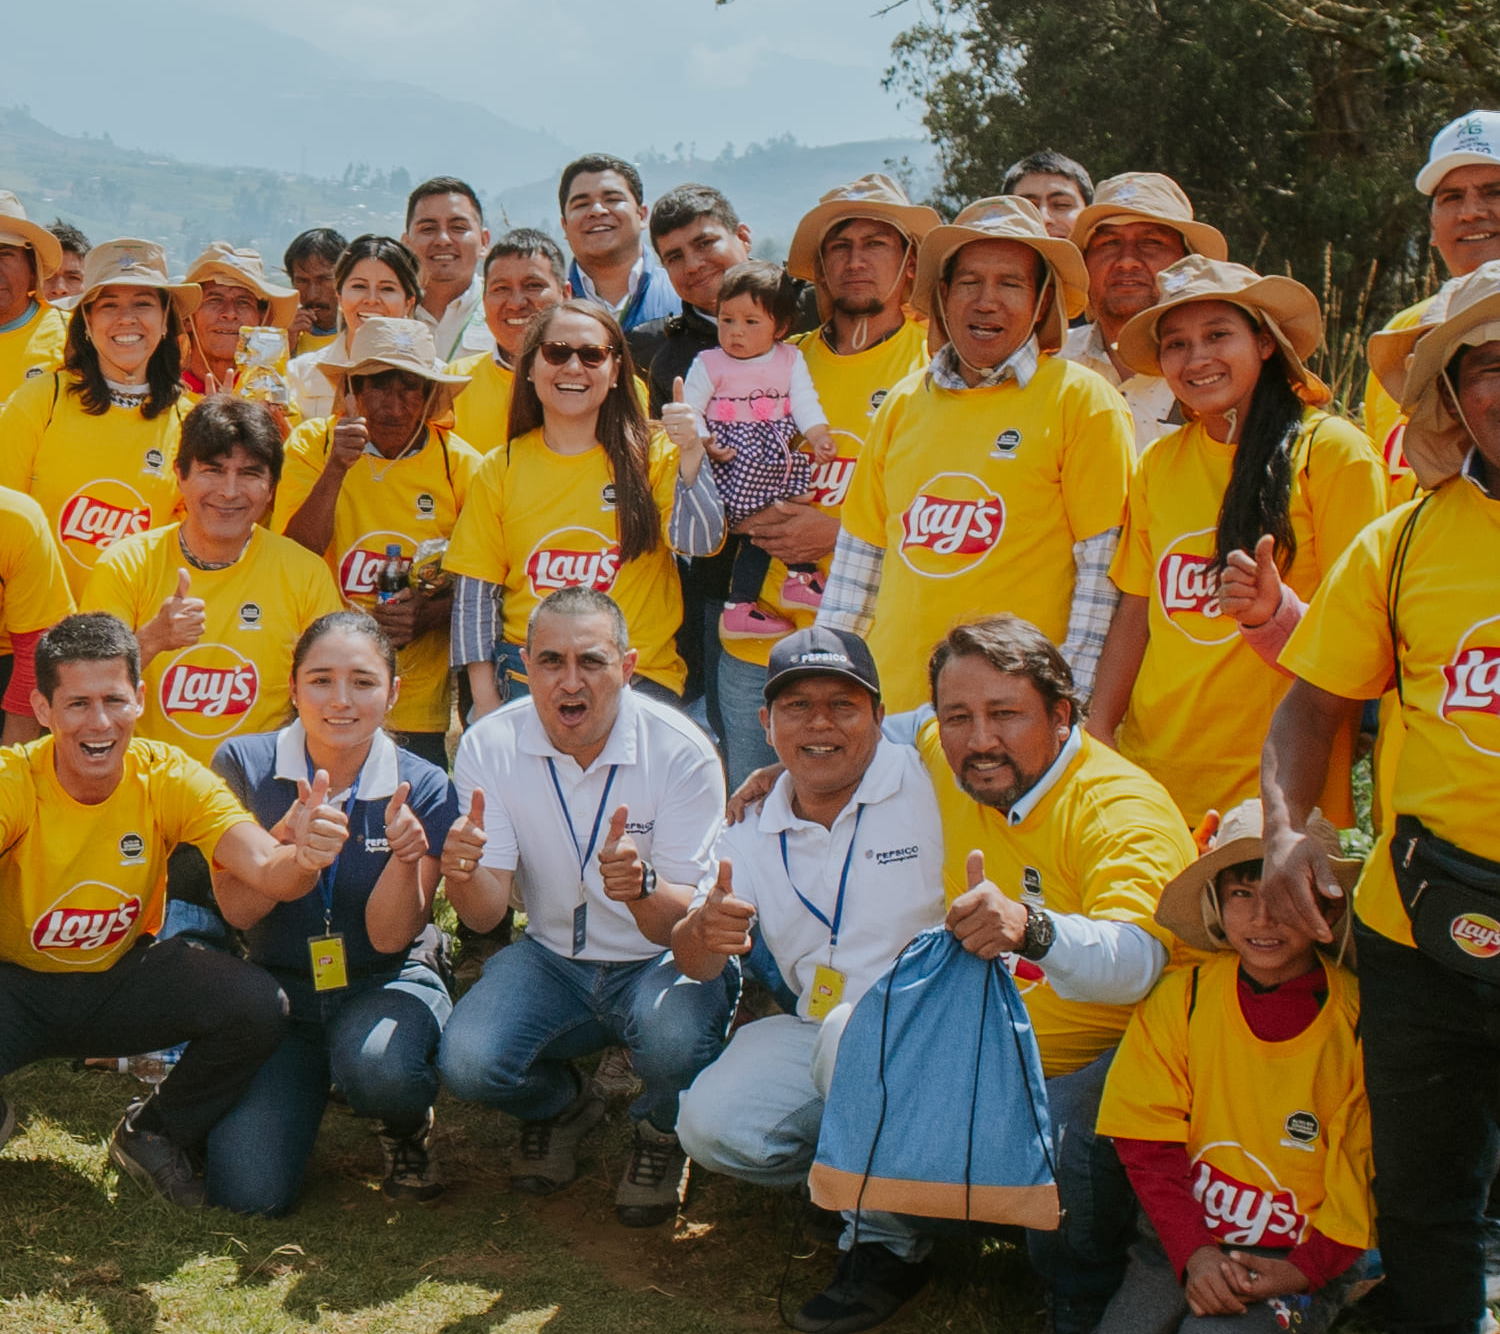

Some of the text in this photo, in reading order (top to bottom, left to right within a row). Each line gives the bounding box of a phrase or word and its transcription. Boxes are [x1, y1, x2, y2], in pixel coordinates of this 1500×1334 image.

[63, 495, 150, 548] Lay's
[906, 496, 999, 555] Lay's
[535, 547, 621, 588] Lay's
[802, 652, 848, 664] PEPSICO
[165, 665, 253, 717] Lay's
[365, 838, 390, 847] PEPS
[876, 845, 919, 860] PEPSICO
[38, 902, 137, 950] Lay's
